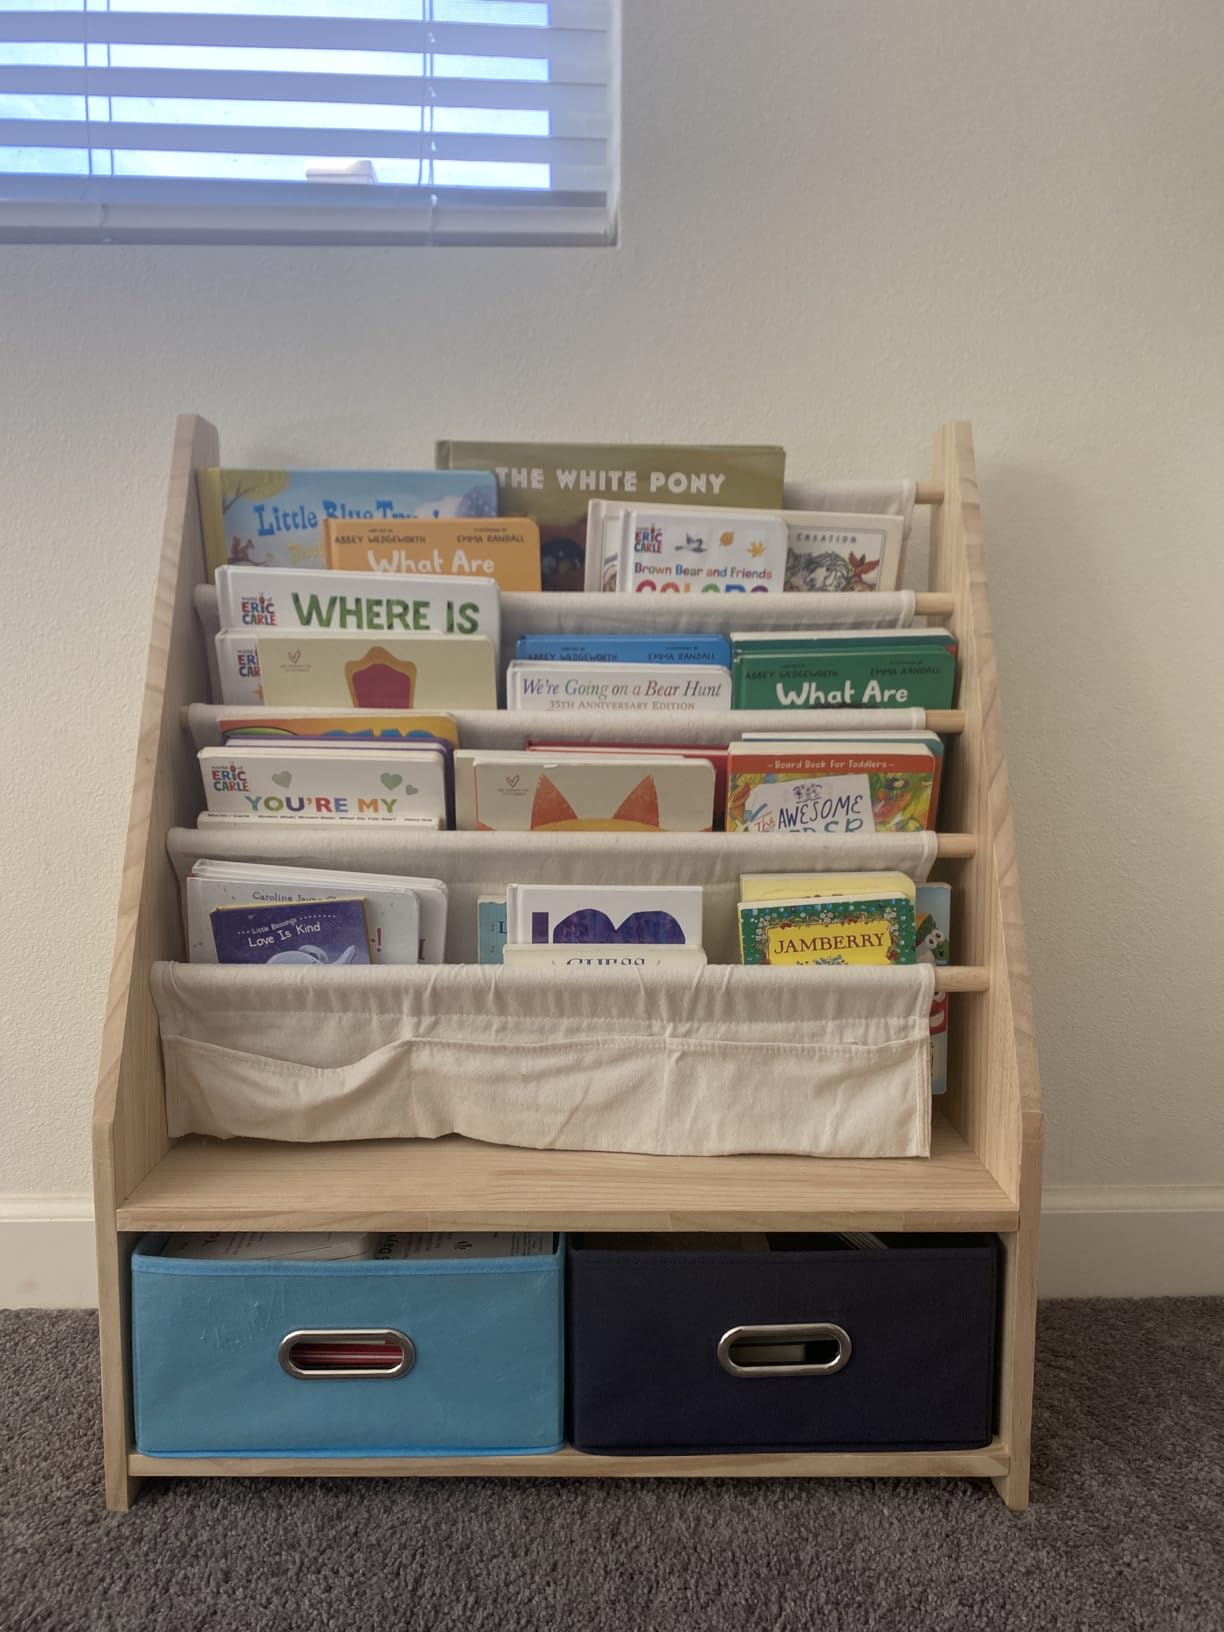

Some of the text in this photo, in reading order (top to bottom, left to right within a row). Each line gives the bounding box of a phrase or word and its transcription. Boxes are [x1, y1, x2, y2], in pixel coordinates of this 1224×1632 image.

[495, 467, 726, 494] THE WHITE PONY
[252, 503, 318, 536] Little
[334, 535, 426, 544] ABBEY WEDGEWORTH
[456, 534, 525, 544] EMMA RANDALL
[634, 529, 663, 544] ERIC
[796, 532, 857, 543] CREATION
[634, 543, 663, 554] CARLE
[367, 549, 495, 574] What Are
[634, 562, 773, 580] Brown Bear and Friends
[241, 597, 275, 615] ERIC
[291, 592, 480, 634] WHERE IS
[242, 614, 277, 626] CARLE
[648, 653, 674, 661] EMMA
[522, 678, 723, 700] We're Going on a Bear Hunt
[776, 680, 908, 705] What Are
[774, 759, 802, 769] Board
[805, 759, 826, 769] Book
[848, 759, 888, 768] Toddlers
[211, 767, 248, 781] ERIC
[213, 781, 250, 792] CARLE
[246, 796, 398, 814] YOU'RE MY
[778, 795, 863, 829] AWESOME
[754, 810, 776, 832] The
[252, 891, 293, 902] Caroline
[248, 921, 321, 947] Love Is Kind
[251, 926, 270, 935] Little
[773, 932, 886, 955] JAMBERRY
